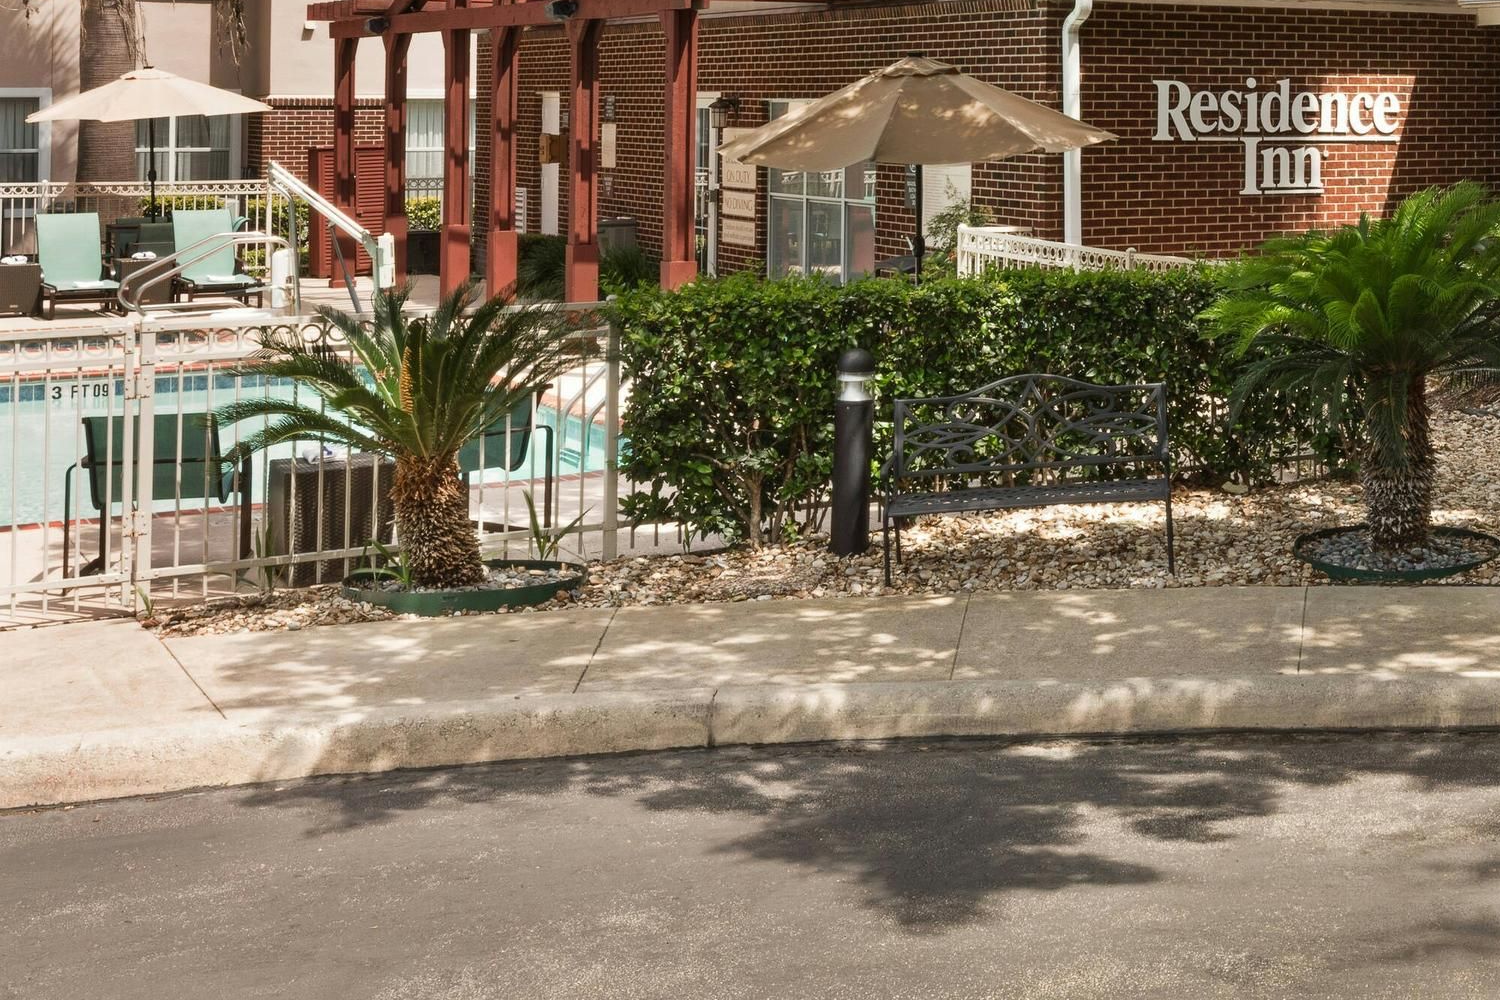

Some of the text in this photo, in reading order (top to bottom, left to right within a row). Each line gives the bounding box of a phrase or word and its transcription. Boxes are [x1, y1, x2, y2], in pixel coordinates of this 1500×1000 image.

[1152, 77, 1401, 141] Residence
[1239, 136, 1325, 195] Inn
[51, 386, 62, 400] 3
